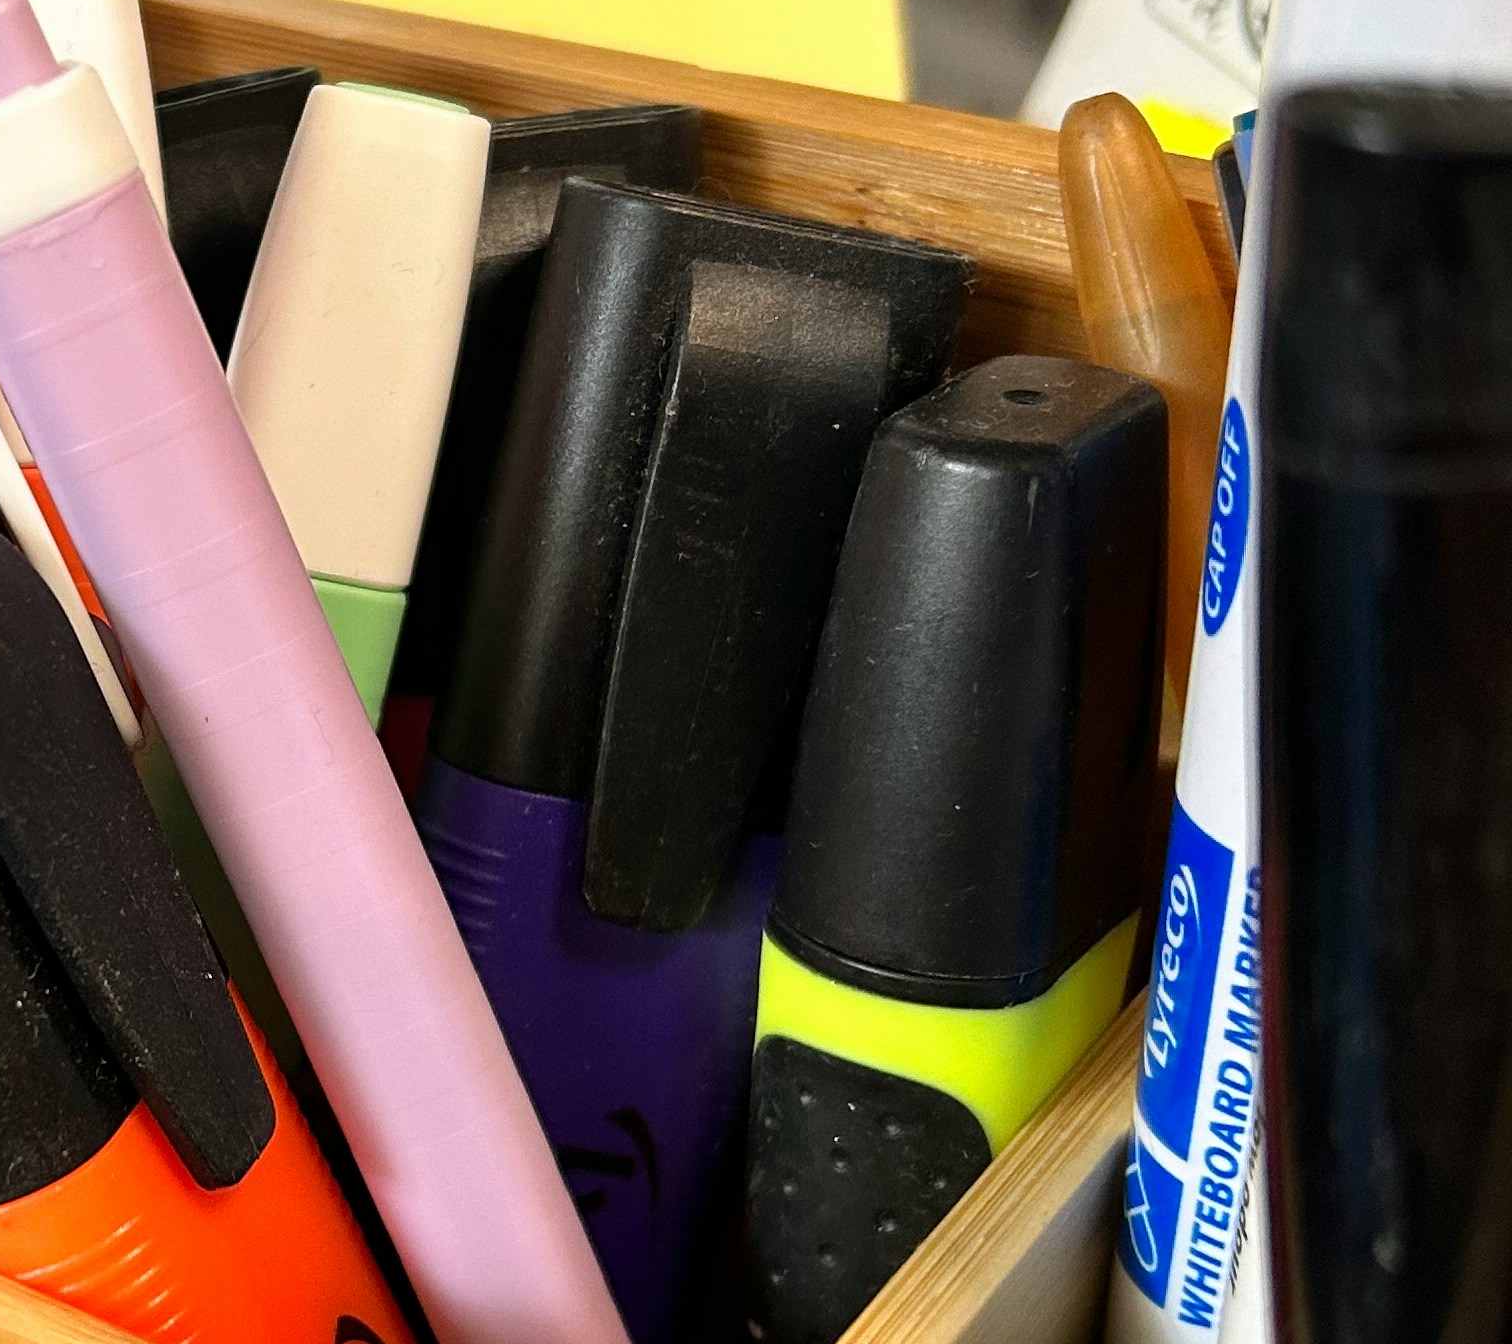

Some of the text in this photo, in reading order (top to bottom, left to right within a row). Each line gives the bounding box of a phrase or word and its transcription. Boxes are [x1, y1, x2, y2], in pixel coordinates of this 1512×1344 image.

[1204, 417, 1241, 618] CAP OFF
[1143, 864, 1202, 1079] Lyreco
[1178, 1059, 1254, 1329] WHITEBOARD
